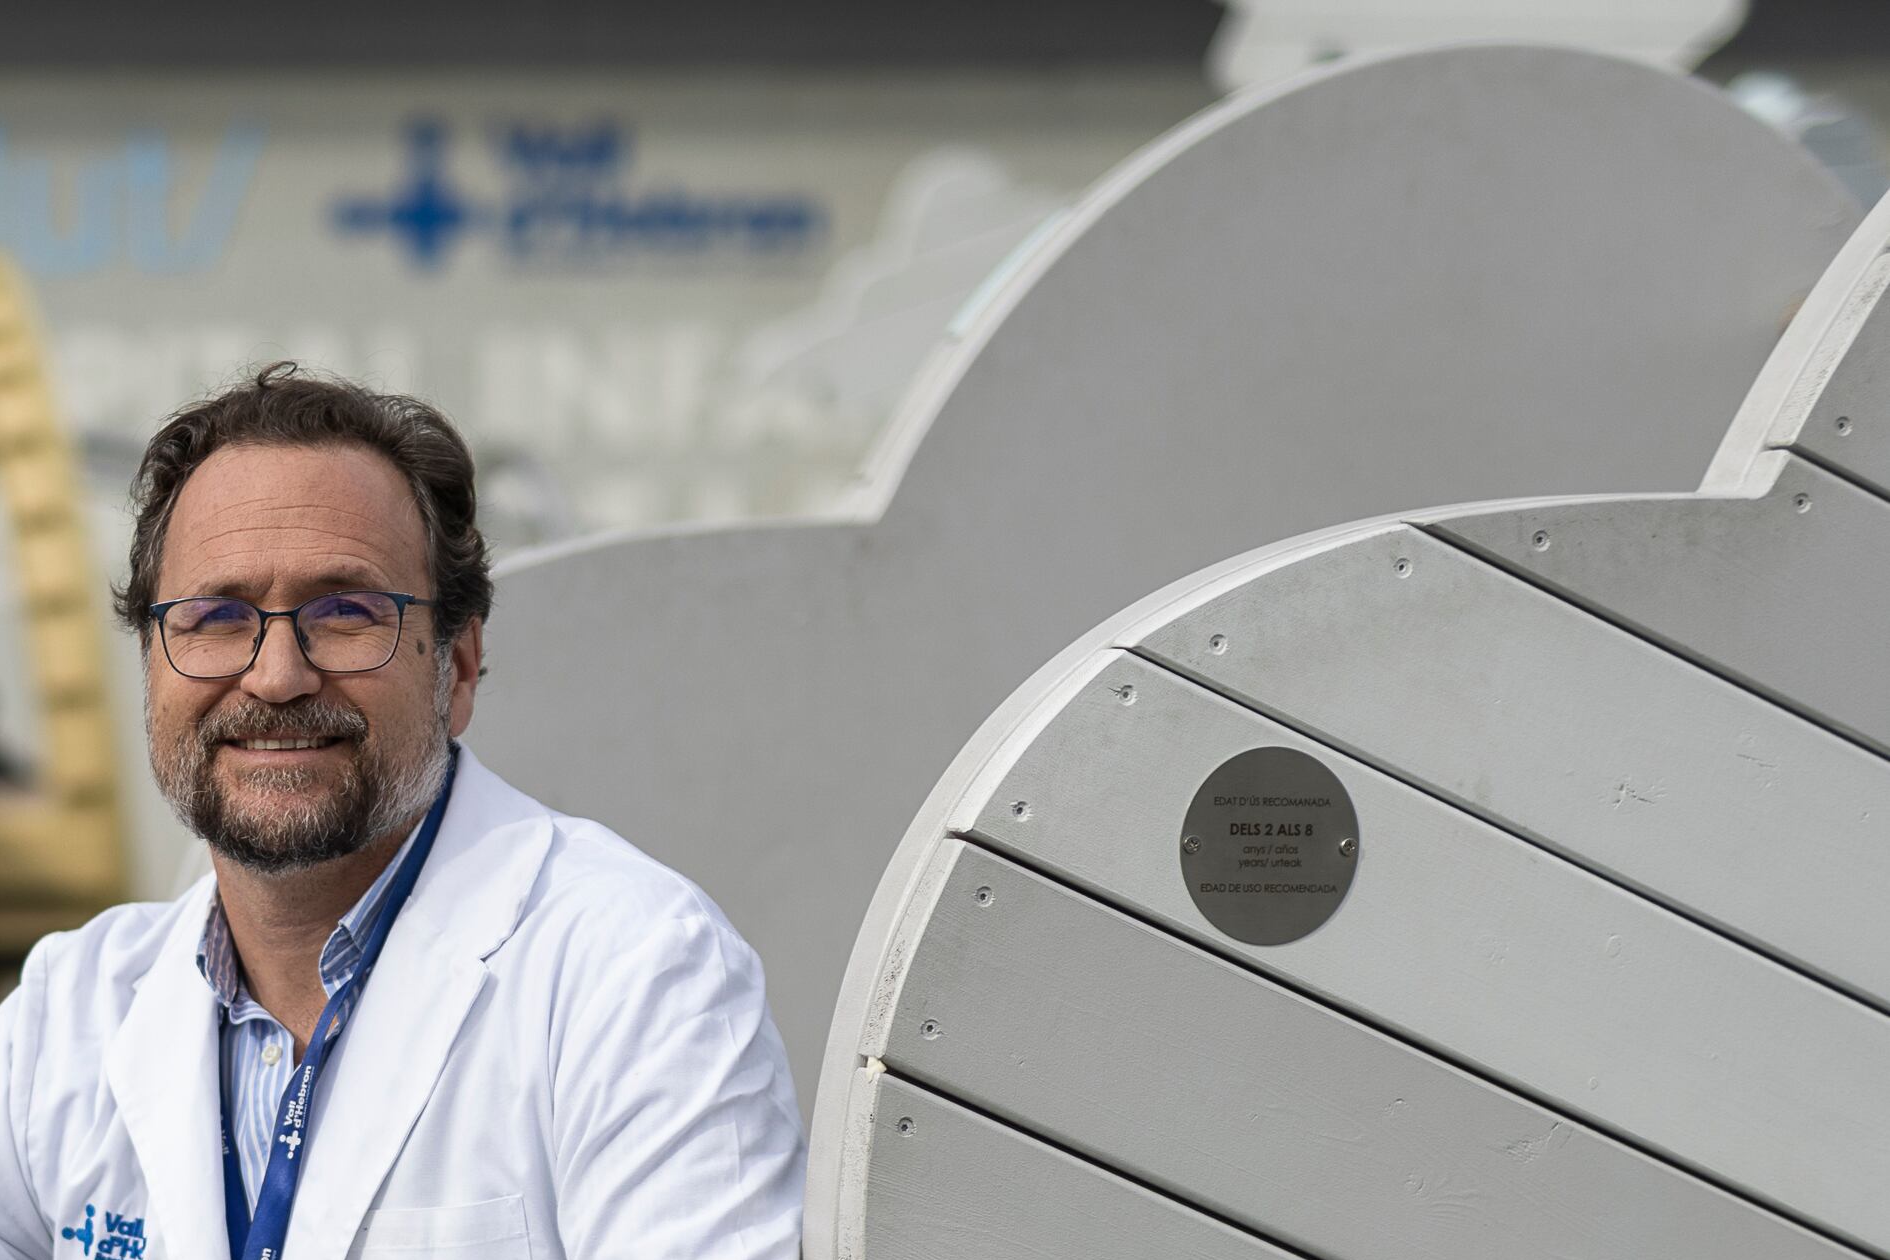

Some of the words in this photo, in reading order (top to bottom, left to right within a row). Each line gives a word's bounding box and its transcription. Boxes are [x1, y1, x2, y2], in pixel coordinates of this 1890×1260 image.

[1214, 796, 1238, 806] EDAT
[1262, 797, 1331, 807] RECOMANADA
[1230, 823, 1261, 836] DELS
[1264, 823, 1273, 836] 2
[1277, 824, 1301, 837] ALS
[1305, 823, 1313, 836] 8
[1243, 846, 1266, 856] anys
[1275, 844, 1299, 855] años
[1271, 858, 1302, 868] urteak
[1200, 883, 1226, 893] EDAD
[1228, 883, 1241, 893] DE
[1242, 883, 1262, 893] USO
[1264, 884, 1338, 894] RECOMENDADA
[293, 1065, 312, 1128] d'Hebron
[283, 1100, 297, 1126] Vall
[105, 1210, 144, 1239] Vall
